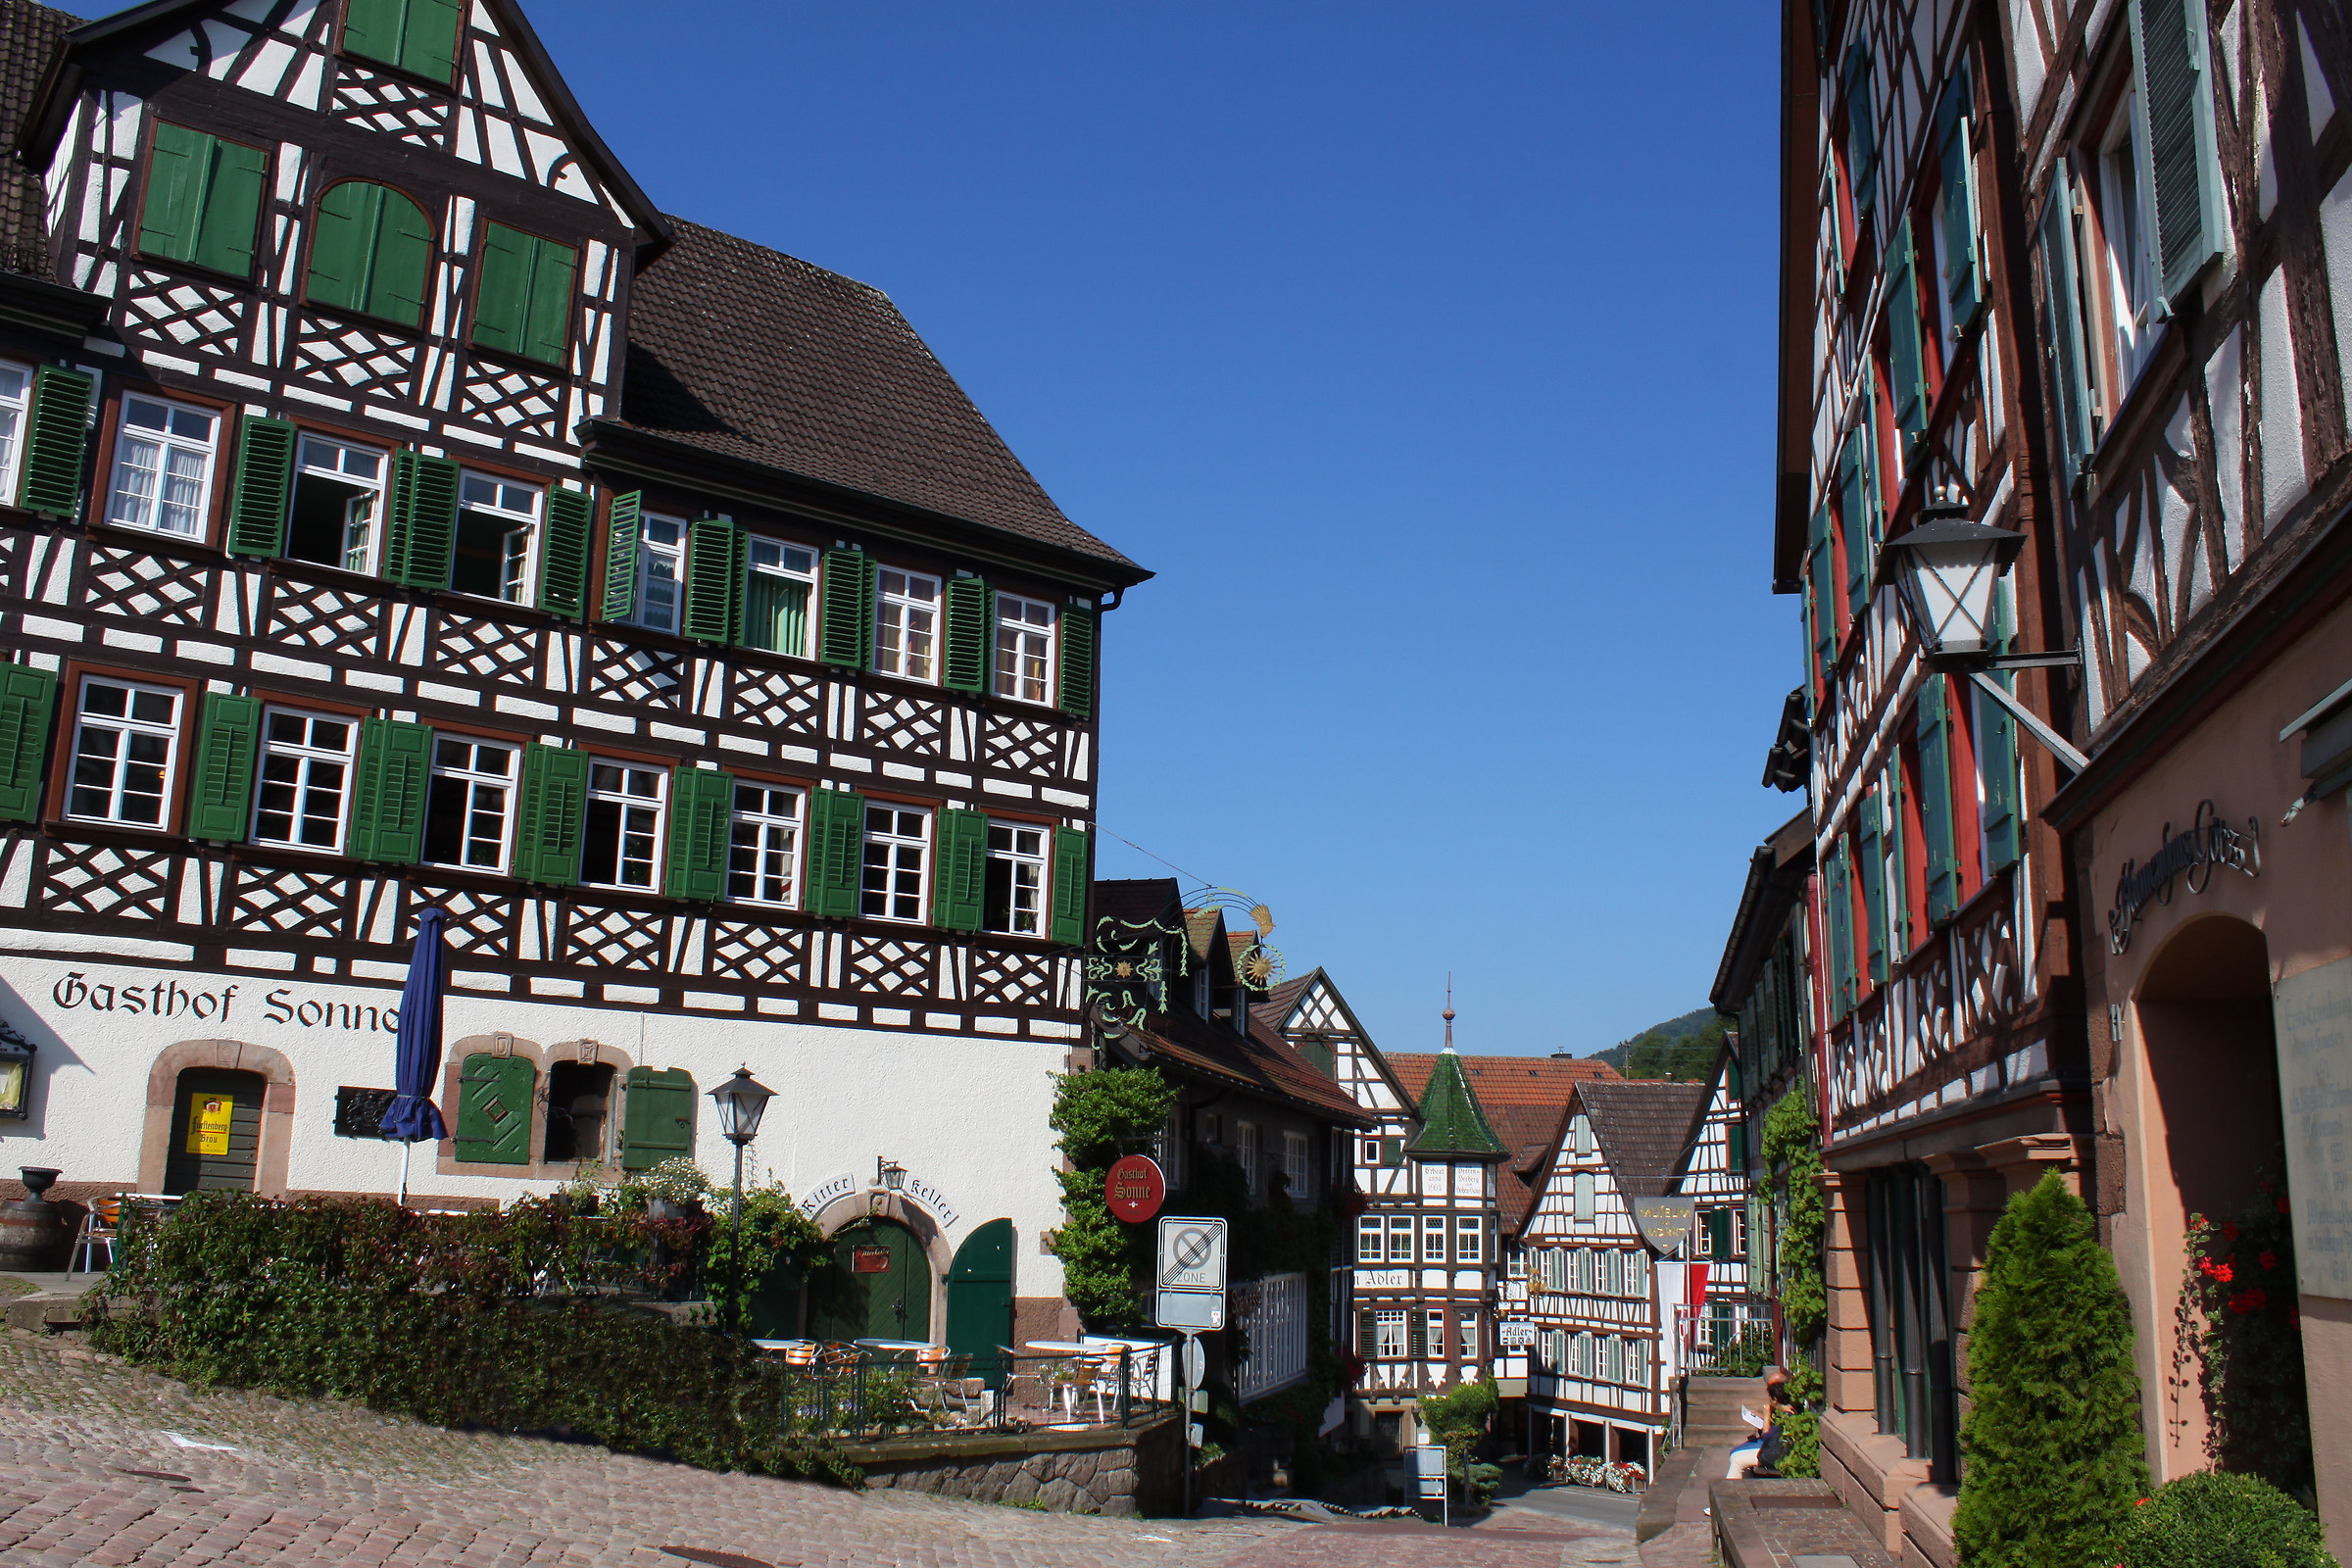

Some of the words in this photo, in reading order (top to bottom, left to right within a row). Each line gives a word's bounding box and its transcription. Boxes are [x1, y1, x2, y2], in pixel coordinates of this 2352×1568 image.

[53, 971, 239, 1022] Gasthof
[264, 989, 400, 1034] Sonne
[1117, 1167, 1148, 1180] Gasthof
[801, 1177, 849, 1214] Ritter
[909, 1179, 952, 1219] Keller
[1113, 1181, 1151, 1200] Sonne
[1176, 1272, 1206, 1284] ZONE
[1365, 1269, 1402, 1287] Adler
[1505, 1326, 1529, 1337] Adler
